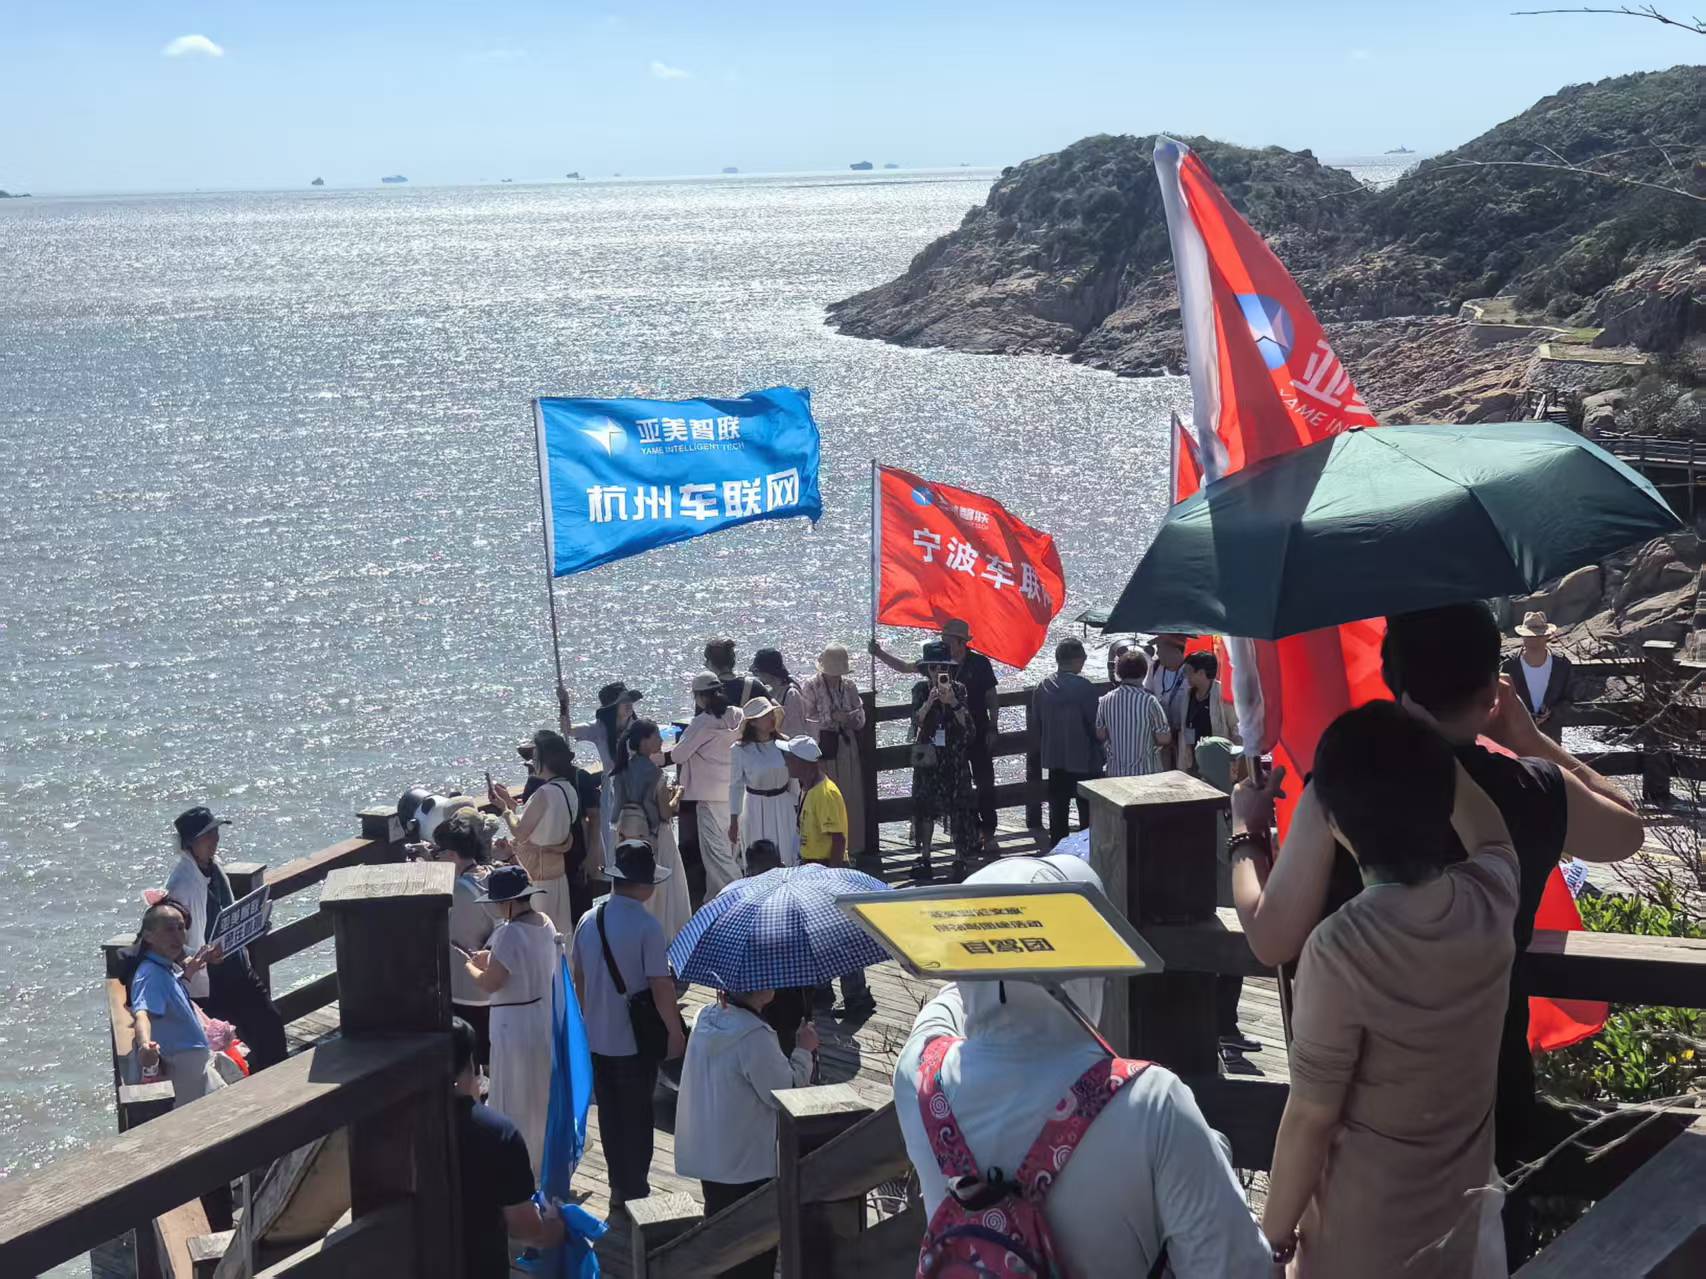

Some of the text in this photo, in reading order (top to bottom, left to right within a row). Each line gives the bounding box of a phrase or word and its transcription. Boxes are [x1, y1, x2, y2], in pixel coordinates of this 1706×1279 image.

[635, 415, 741, 444] 亚美智联
[640, 441, 745, 455] YAME INTELLIGENT TECH
[586, 467, 799, 523] 杭州车联网
[913, 528, 1051, 607] 宁波车联
[960, 937, 1056, 954] 自驾团
